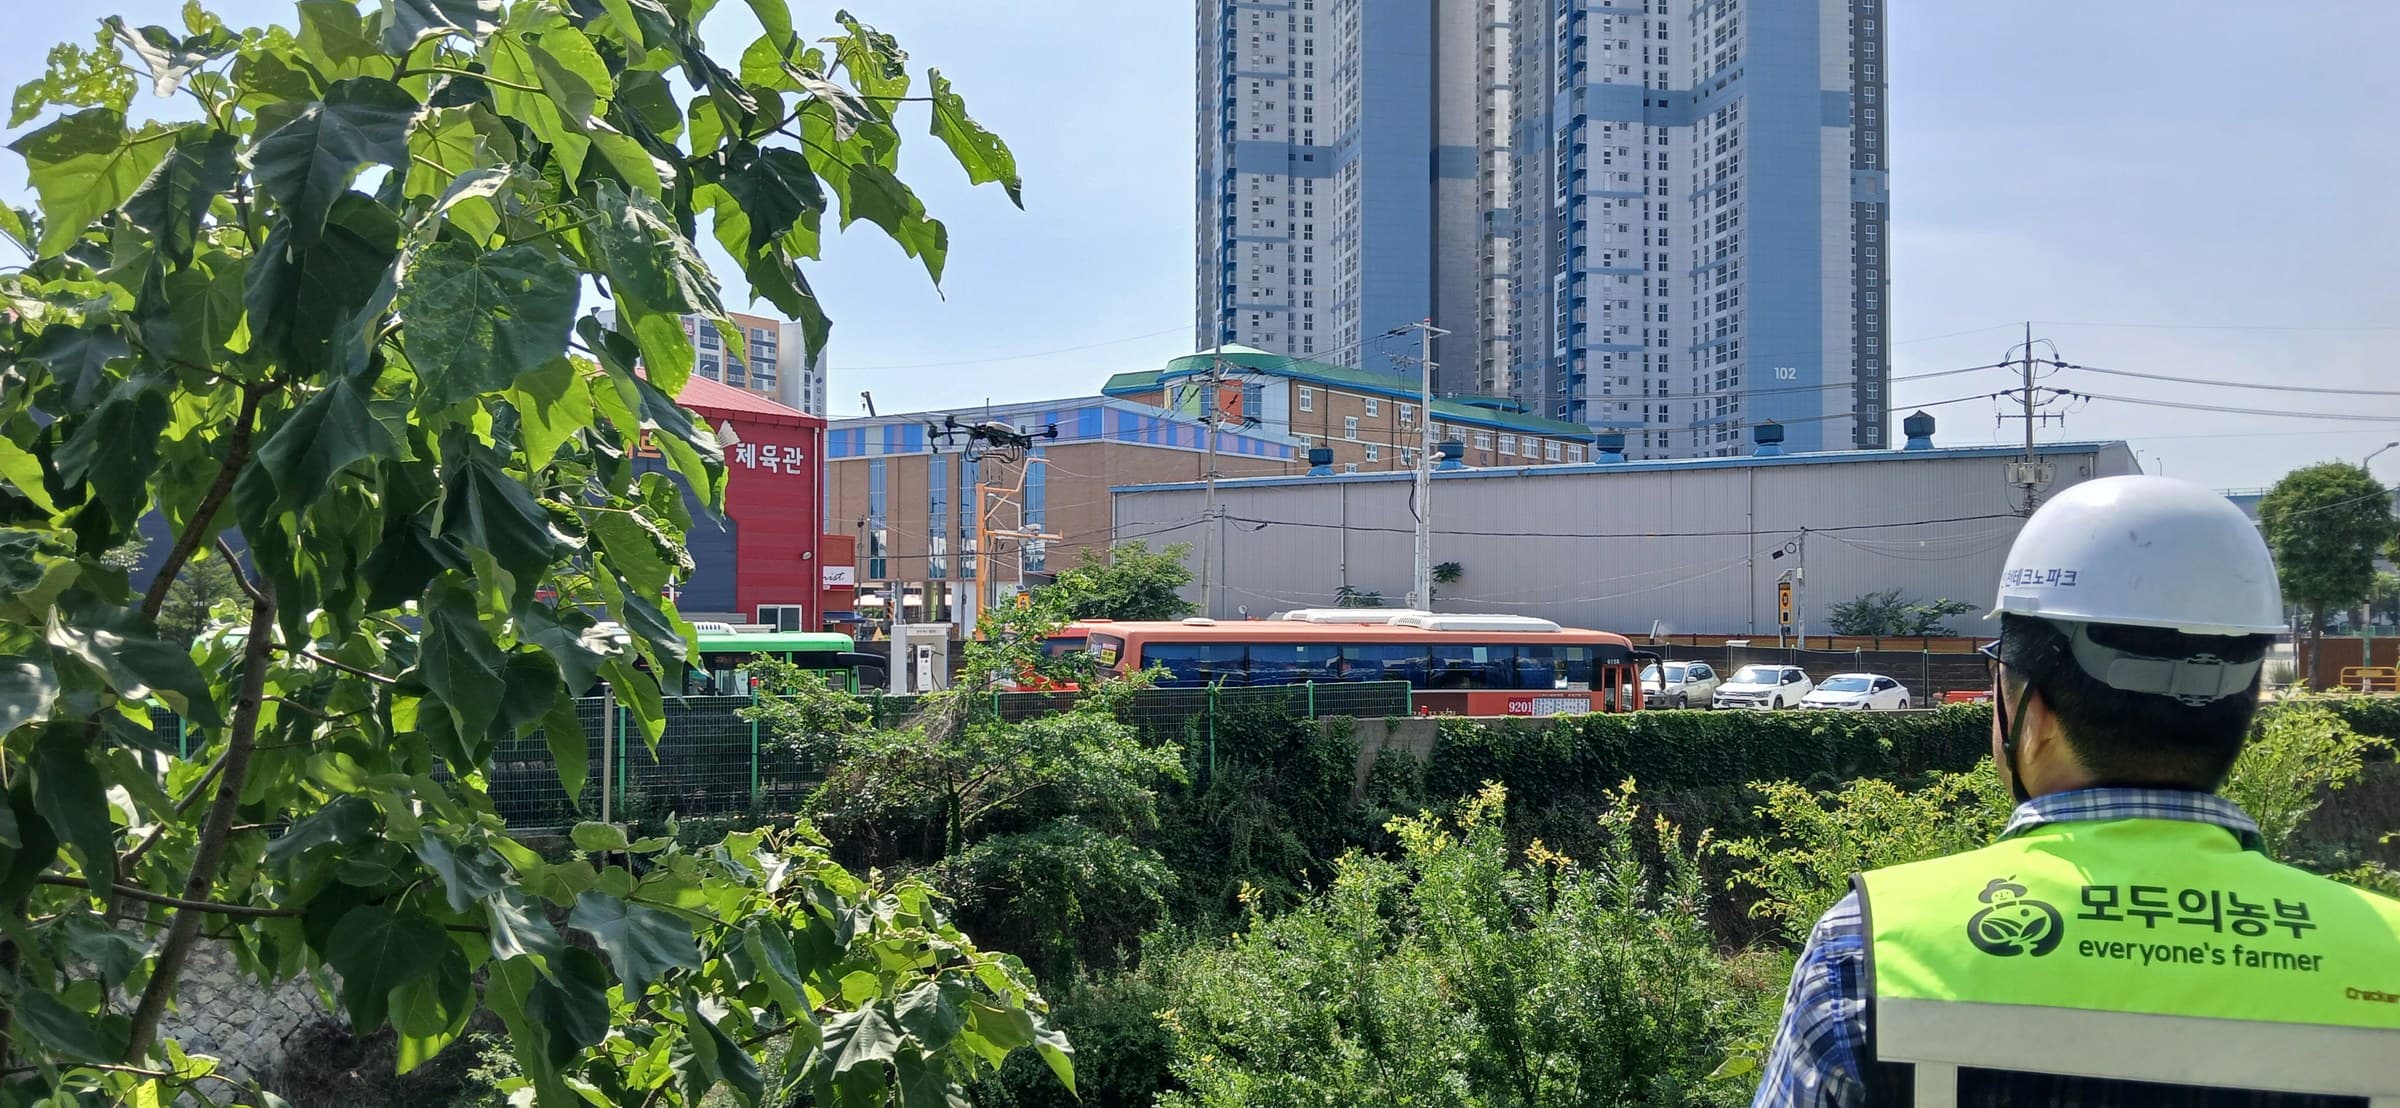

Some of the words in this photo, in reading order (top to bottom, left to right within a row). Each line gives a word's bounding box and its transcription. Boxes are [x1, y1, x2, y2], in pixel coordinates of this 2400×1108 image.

[1774, 367, 1796, 380] 102
[735, 442, 804, 475] 체육관
[1508, 701, 1532, 713] 9201
[2077, 884, 2318, 939] 모두의농부
[2078, 939, 2226, 967] everyone's
[2232, 944, 2324, 973] farmer
